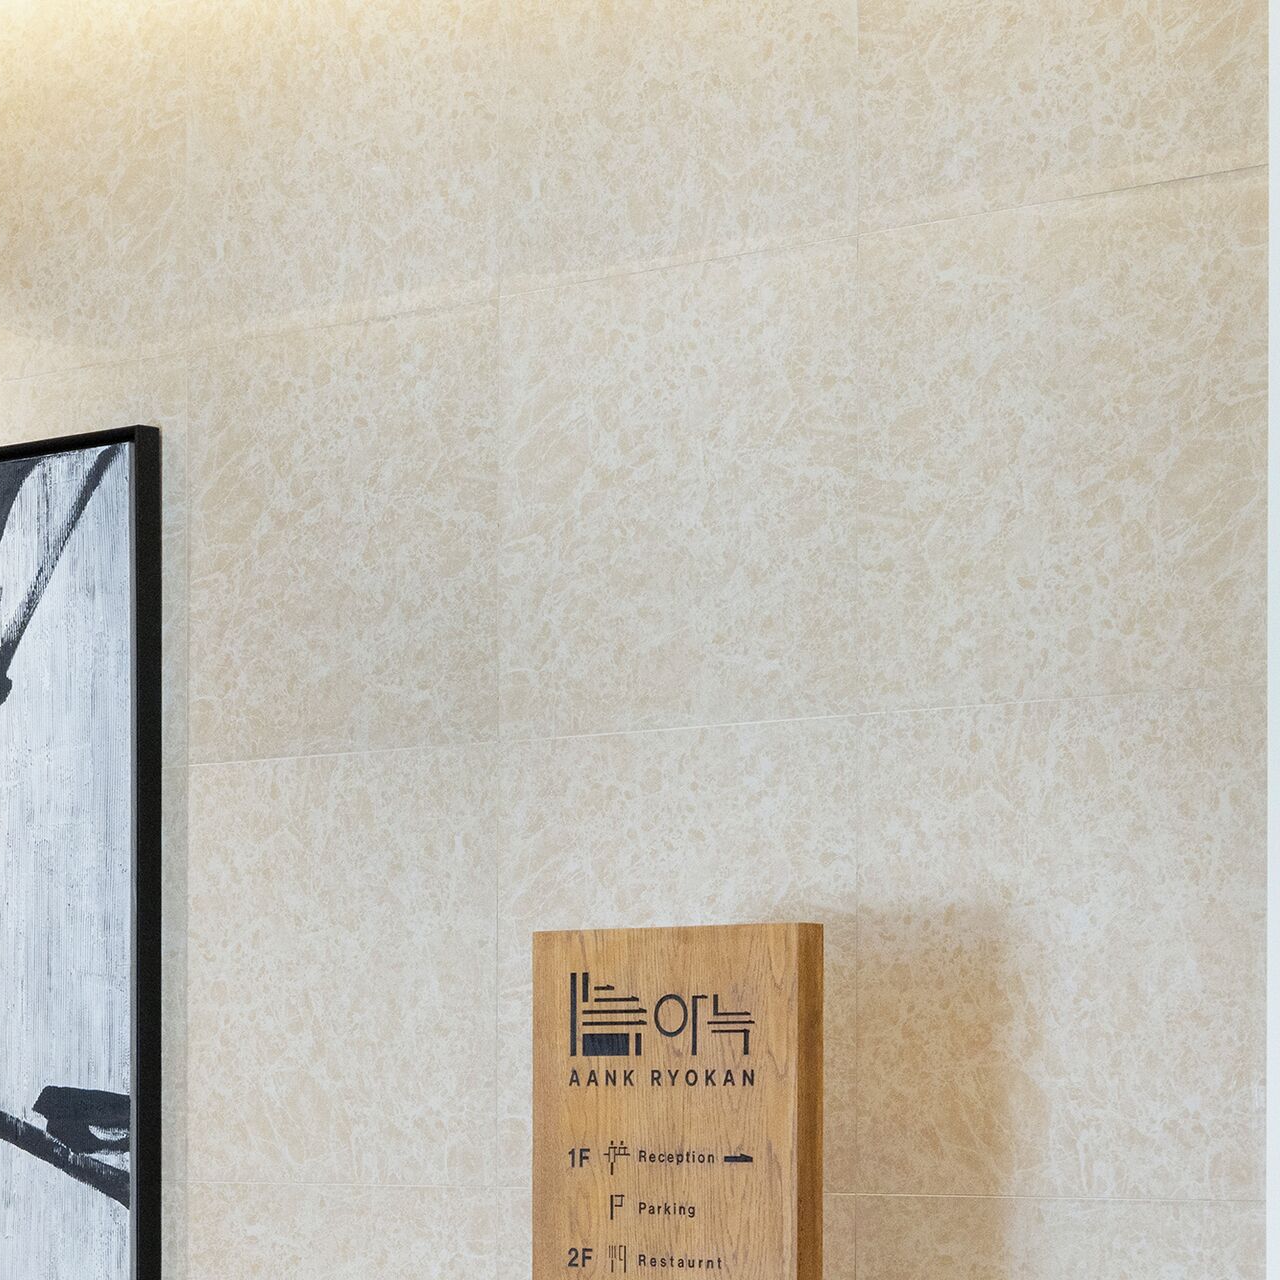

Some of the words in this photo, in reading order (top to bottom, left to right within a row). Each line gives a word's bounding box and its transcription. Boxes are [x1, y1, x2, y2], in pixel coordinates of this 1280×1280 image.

[569, 1069, 636, 1087] AANK
[650, 1069, 756, 1087] RYOKAN
[568, 1148, 591, 1168] 1F
[638, 1150, 716, 1165] Reception
[638, 1201, 697, 1218] Parking
[567, 1247, 593, 1268] 2F
[638, 1254, 723, 1270] Restaurnt
